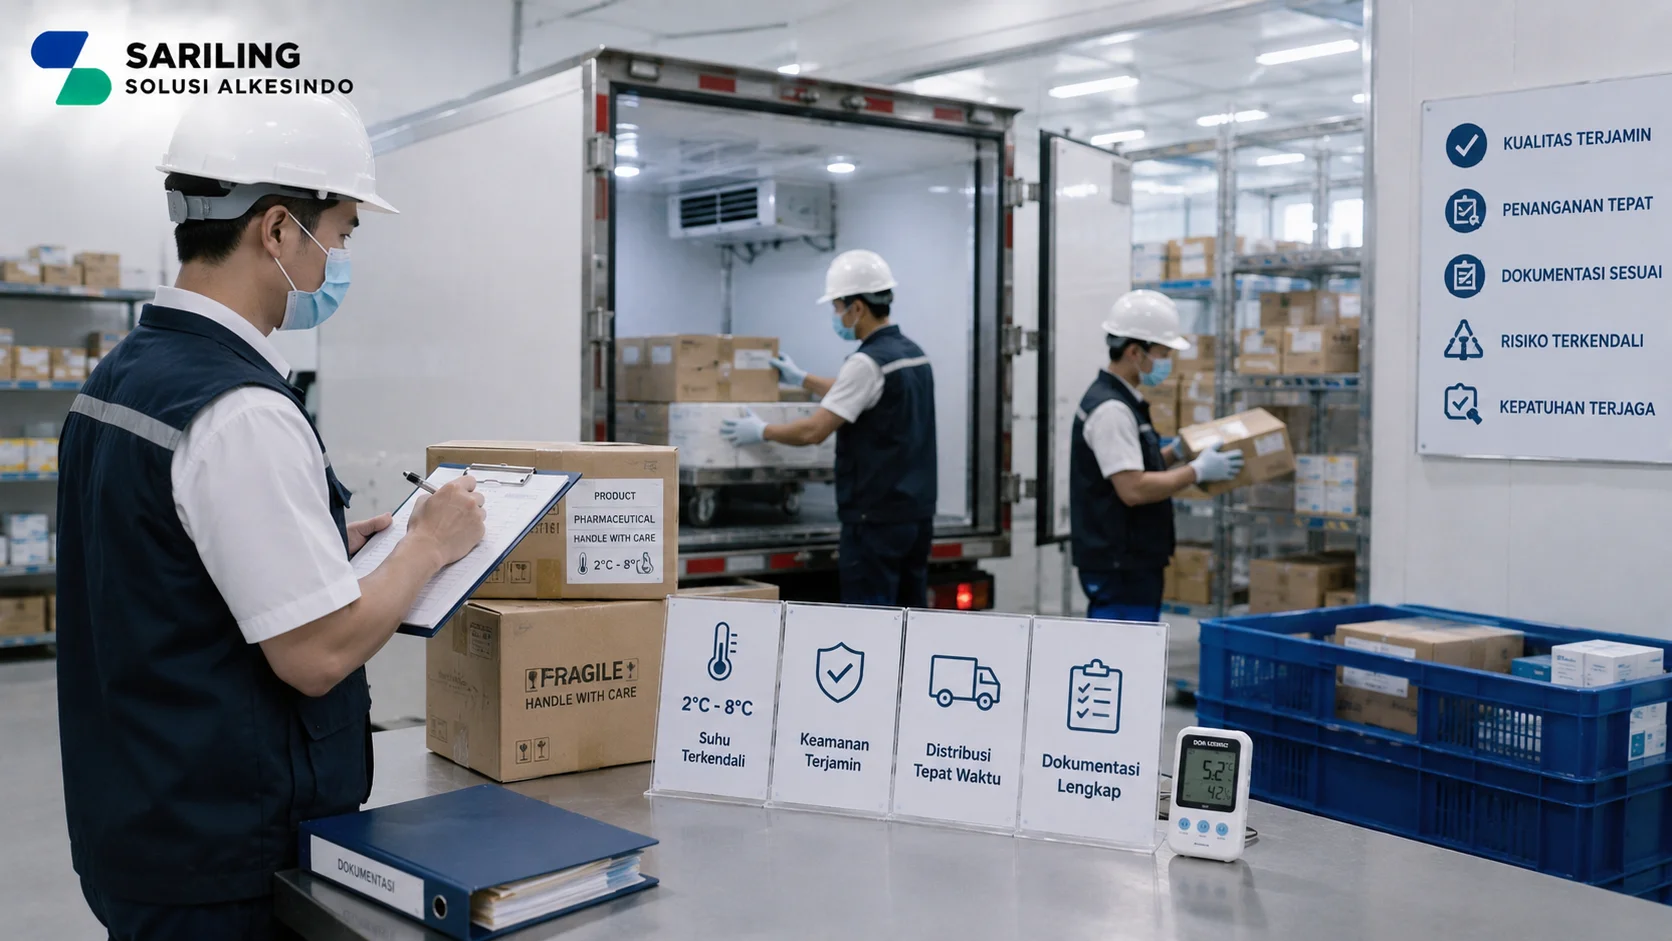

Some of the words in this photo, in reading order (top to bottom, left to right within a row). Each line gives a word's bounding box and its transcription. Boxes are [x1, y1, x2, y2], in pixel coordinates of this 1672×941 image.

[1503, 132, 1573, 151] KUALITAS
[1576, 127, 1652, 146] TERJAMIN
[1503, 198, 1604, 217] PENANGANAN
[1607, 195, 1654, 212] TEPAT
[1501, 266, 1605, 283] DOKUMENTASI
[1609, 264, 1662, 281] SESUAI
[1501, 333, 1549, 349] RISIKO
[1551, 333, 1644, 348] TERKENDALI
[1499, 399, 1585, 415] KEPATUHAN
[1588, 401, 1656, 417] TERJAGA
[594, 491, 637, 501] PRODUCT
[573, 514, 656, 524] PHARMACEUTICAL
[573, 533, 608, 543] HANDLE
[609, 533, 631, 543] WITH
[633, 533, 656, 543] CARE
[593, 559, 614, 571] 2°C
[540, 660, 623, 687] FRAGILE
[525, 693, 573, 710] HANDLE
[575, 689, 605, 704] WITH
[608, 685, 637, 701] CARE
[681, 695, 711, 713] 2°C
[724, 699, 753, 717] 8°C
[698, 731, 731, 747] Suhu
[800, 732, 870, 752] Keamanan
[681, 748, 746, 768] Terkendali
[804, 753, 861, 772] Terjamin
[926, 742, 992, 763] Distribusi
[913, 763, 953, 782] Tepat
[956, 767, 1001, 786] Waktu
[1042, 753, 1140, 777] Dokumentasi
[1057, 778, 1122, 802] Lengkap
[337, 858, 395, 893] DOKUMENTASI
